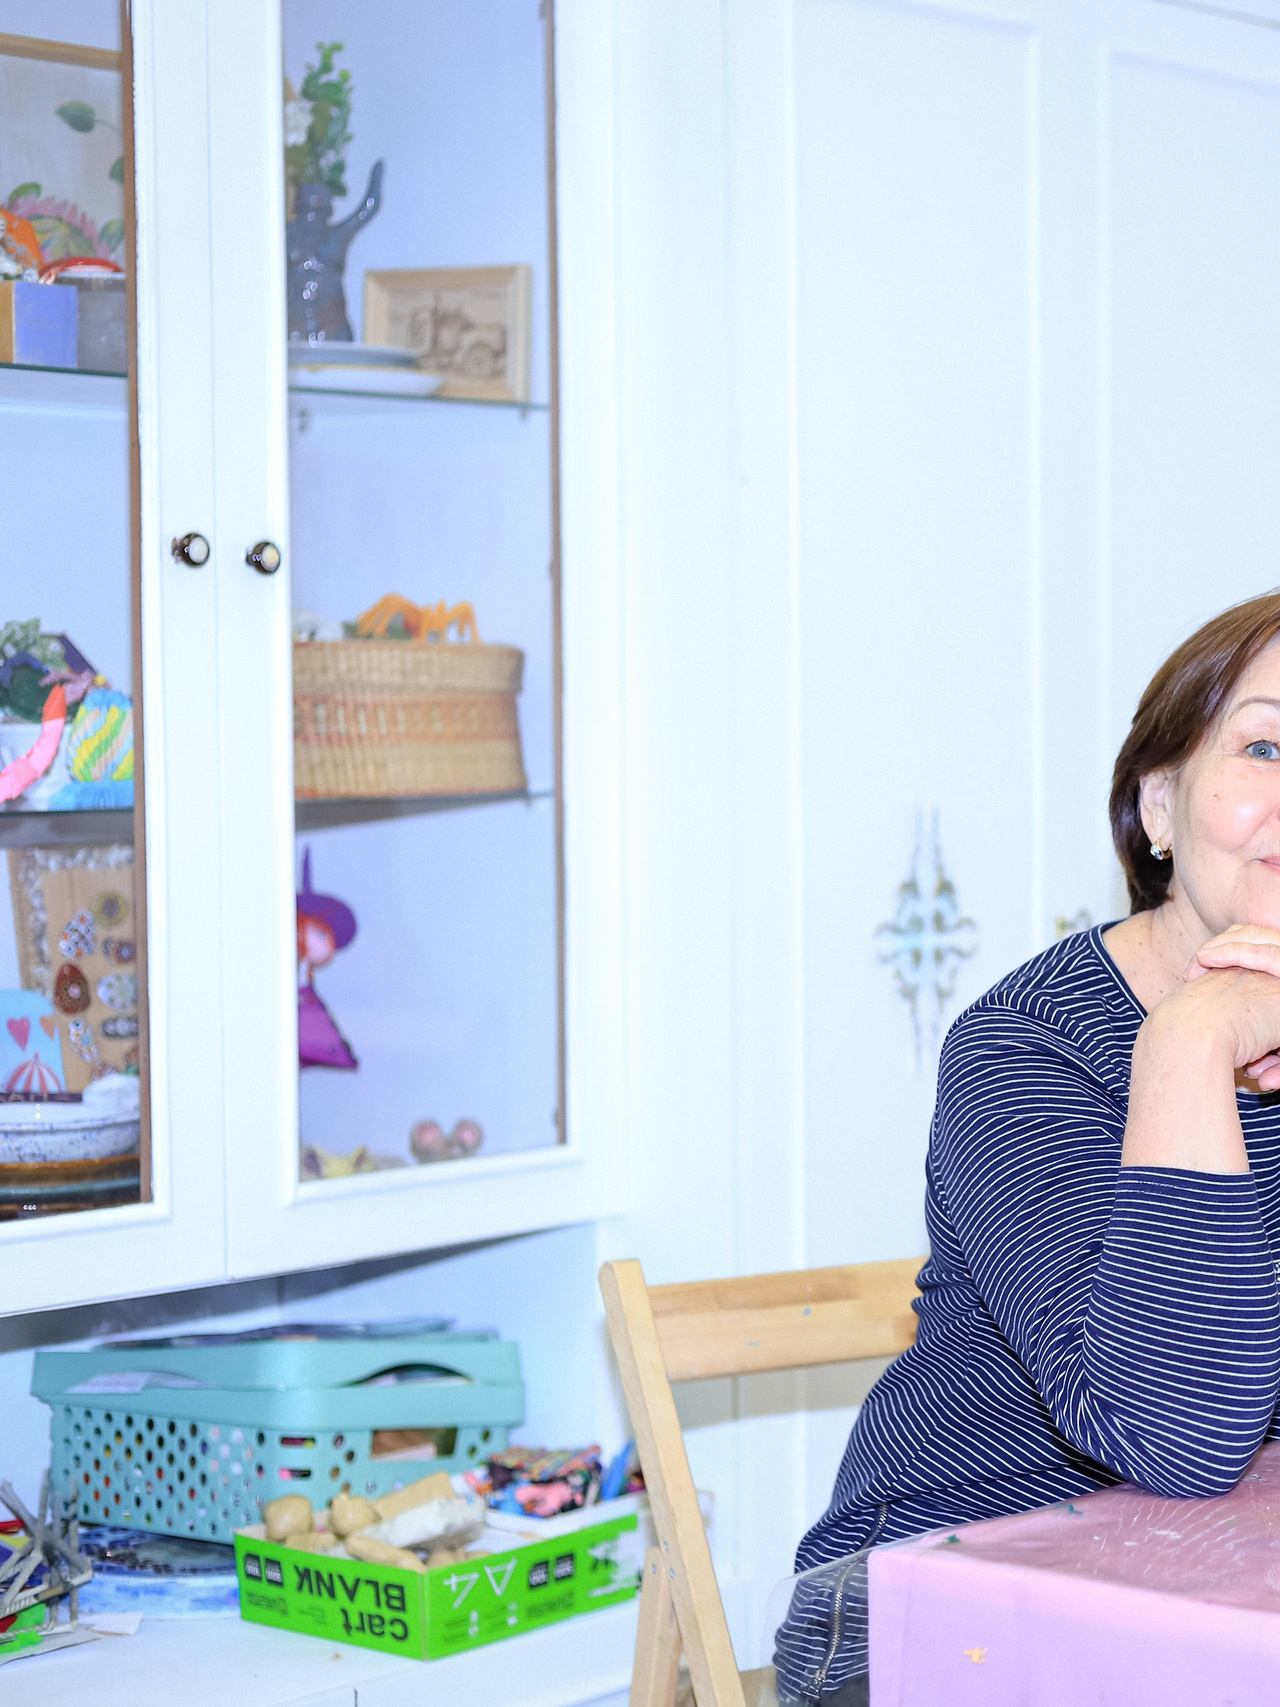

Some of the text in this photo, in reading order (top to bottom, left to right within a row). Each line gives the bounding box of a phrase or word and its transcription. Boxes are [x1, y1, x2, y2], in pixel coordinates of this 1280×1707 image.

[294, 1564, 407, 1613] BLANK
[442, 1557, 517, 1609] A4
[340, 1607, 409, 1642] cart
